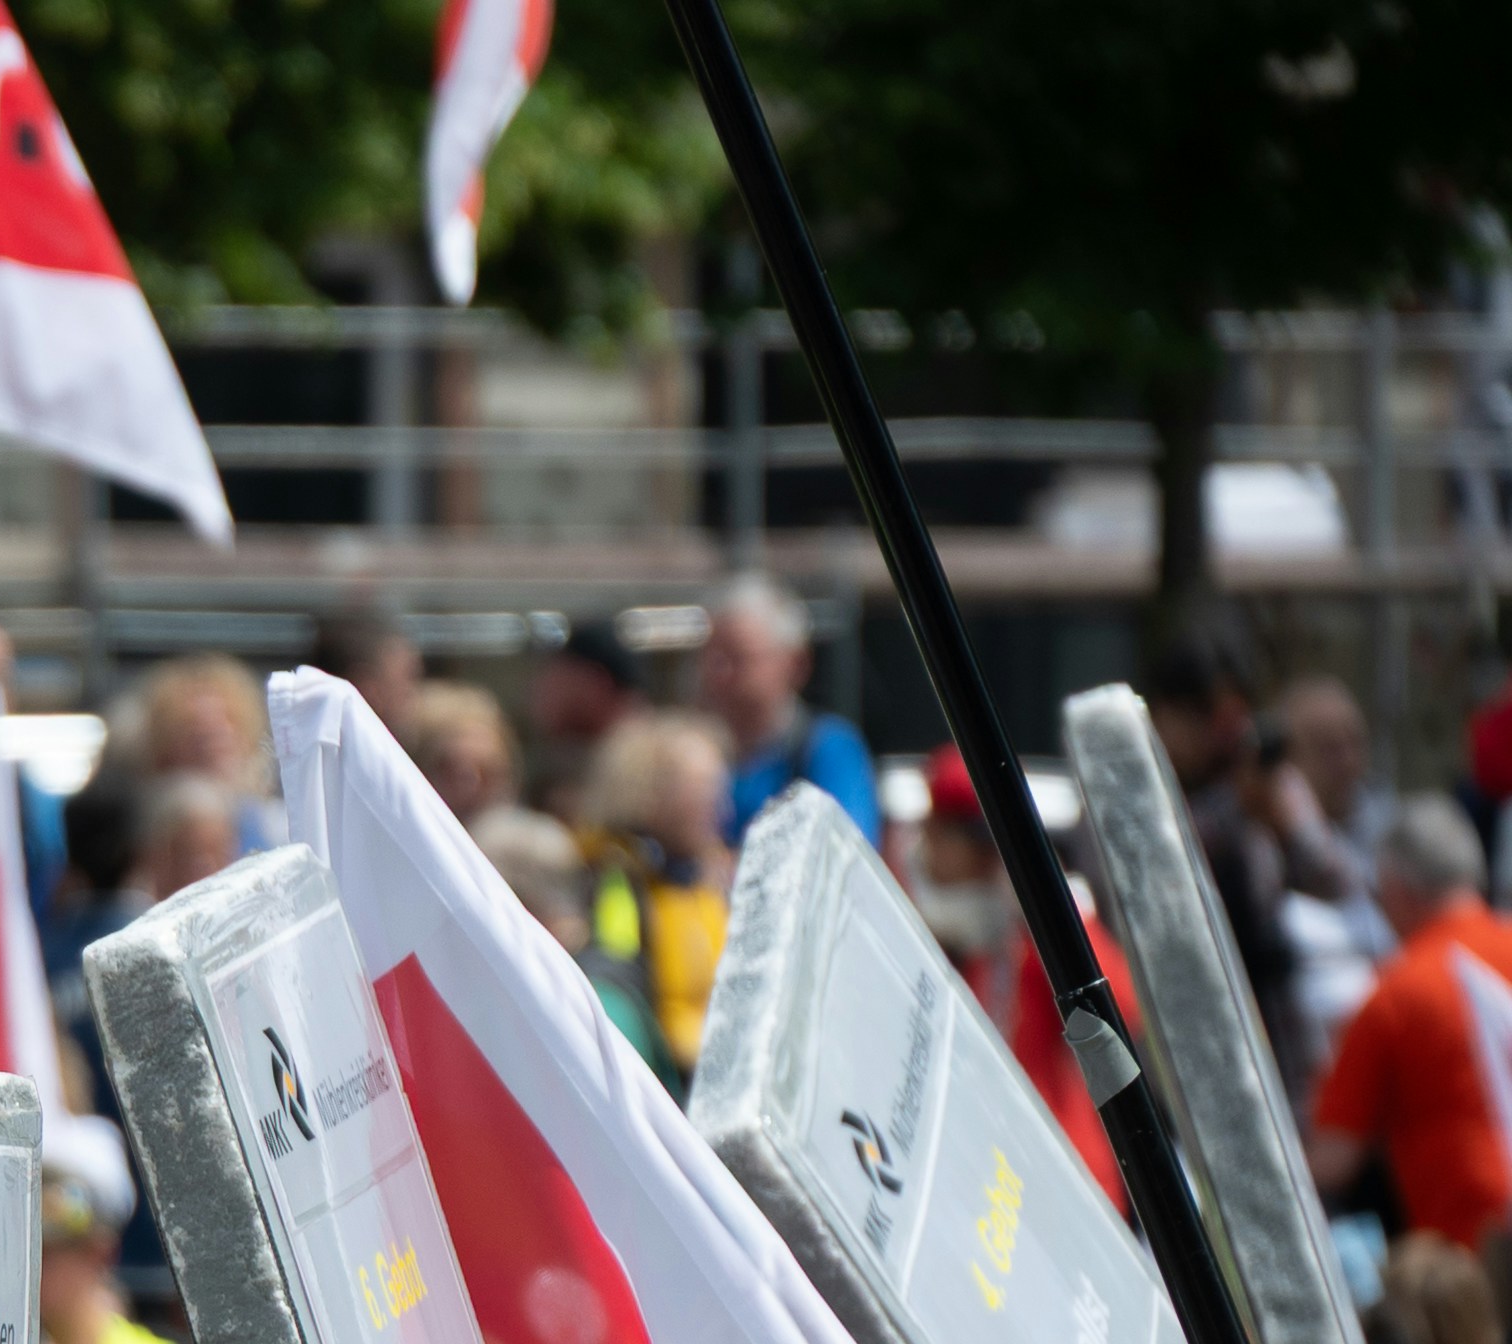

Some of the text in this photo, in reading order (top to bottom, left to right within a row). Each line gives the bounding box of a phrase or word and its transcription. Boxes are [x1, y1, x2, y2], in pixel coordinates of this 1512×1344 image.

[976, 1143, 1026, 1276] Gebot
[358, 1236, 428, 1332] 6. Gebot
